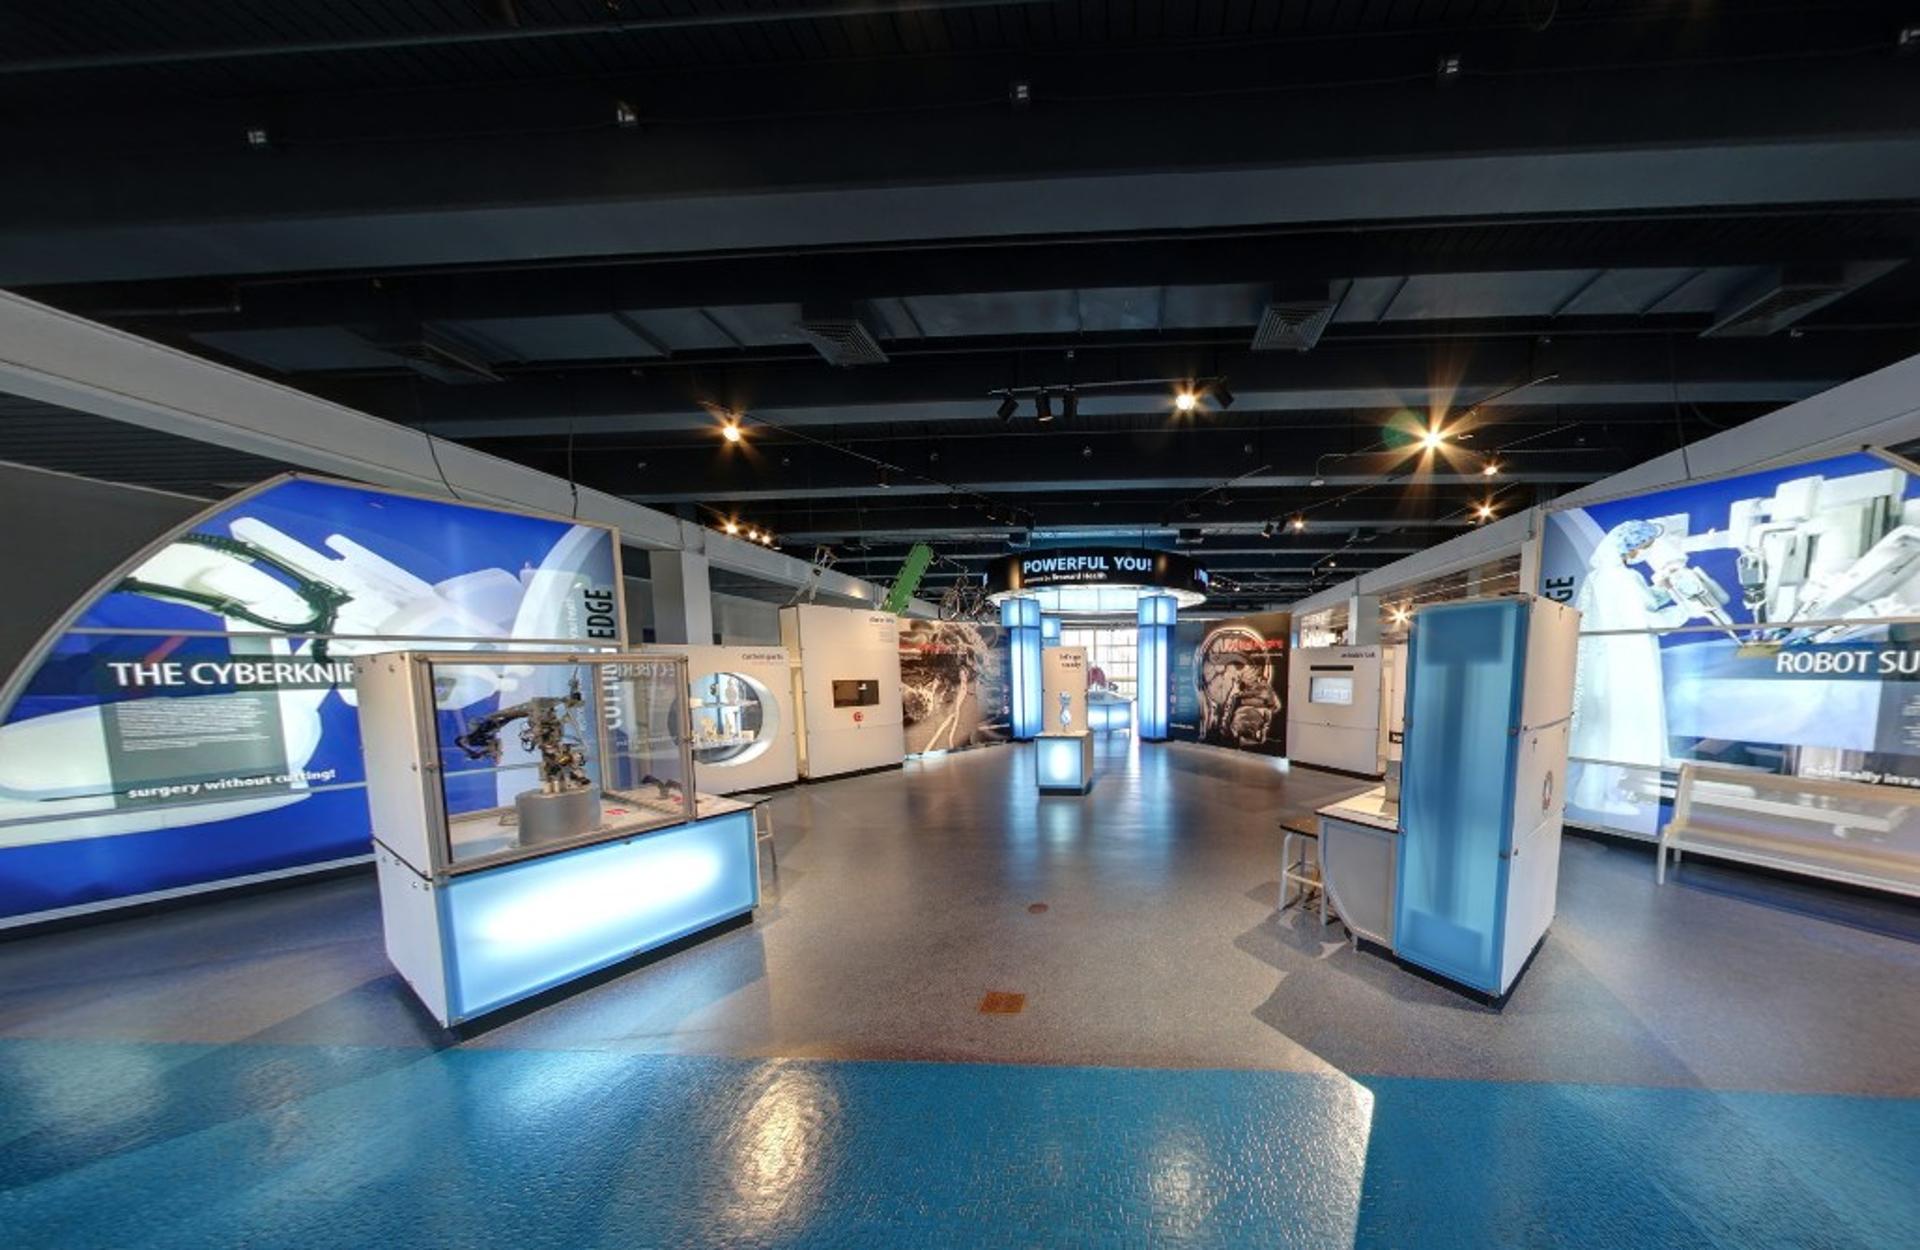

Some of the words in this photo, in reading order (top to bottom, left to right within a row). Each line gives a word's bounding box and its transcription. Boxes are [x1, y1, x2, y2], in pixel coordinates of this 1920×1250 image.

[1023, 556, 1110, 574] POWERFUL
[1113, 556, 1152, 572] YOU!
[584, 589, 616, 639] EDGE
[107, 662, 186, 686] THE
[1775, 650, 1874, 674] ROBOT
[1877, 650, 1920, 674] SU
[127, 783, 200, 799] surgery
[204, 775, 273, 791] without
[275, 769, 336, 784] cutting!
